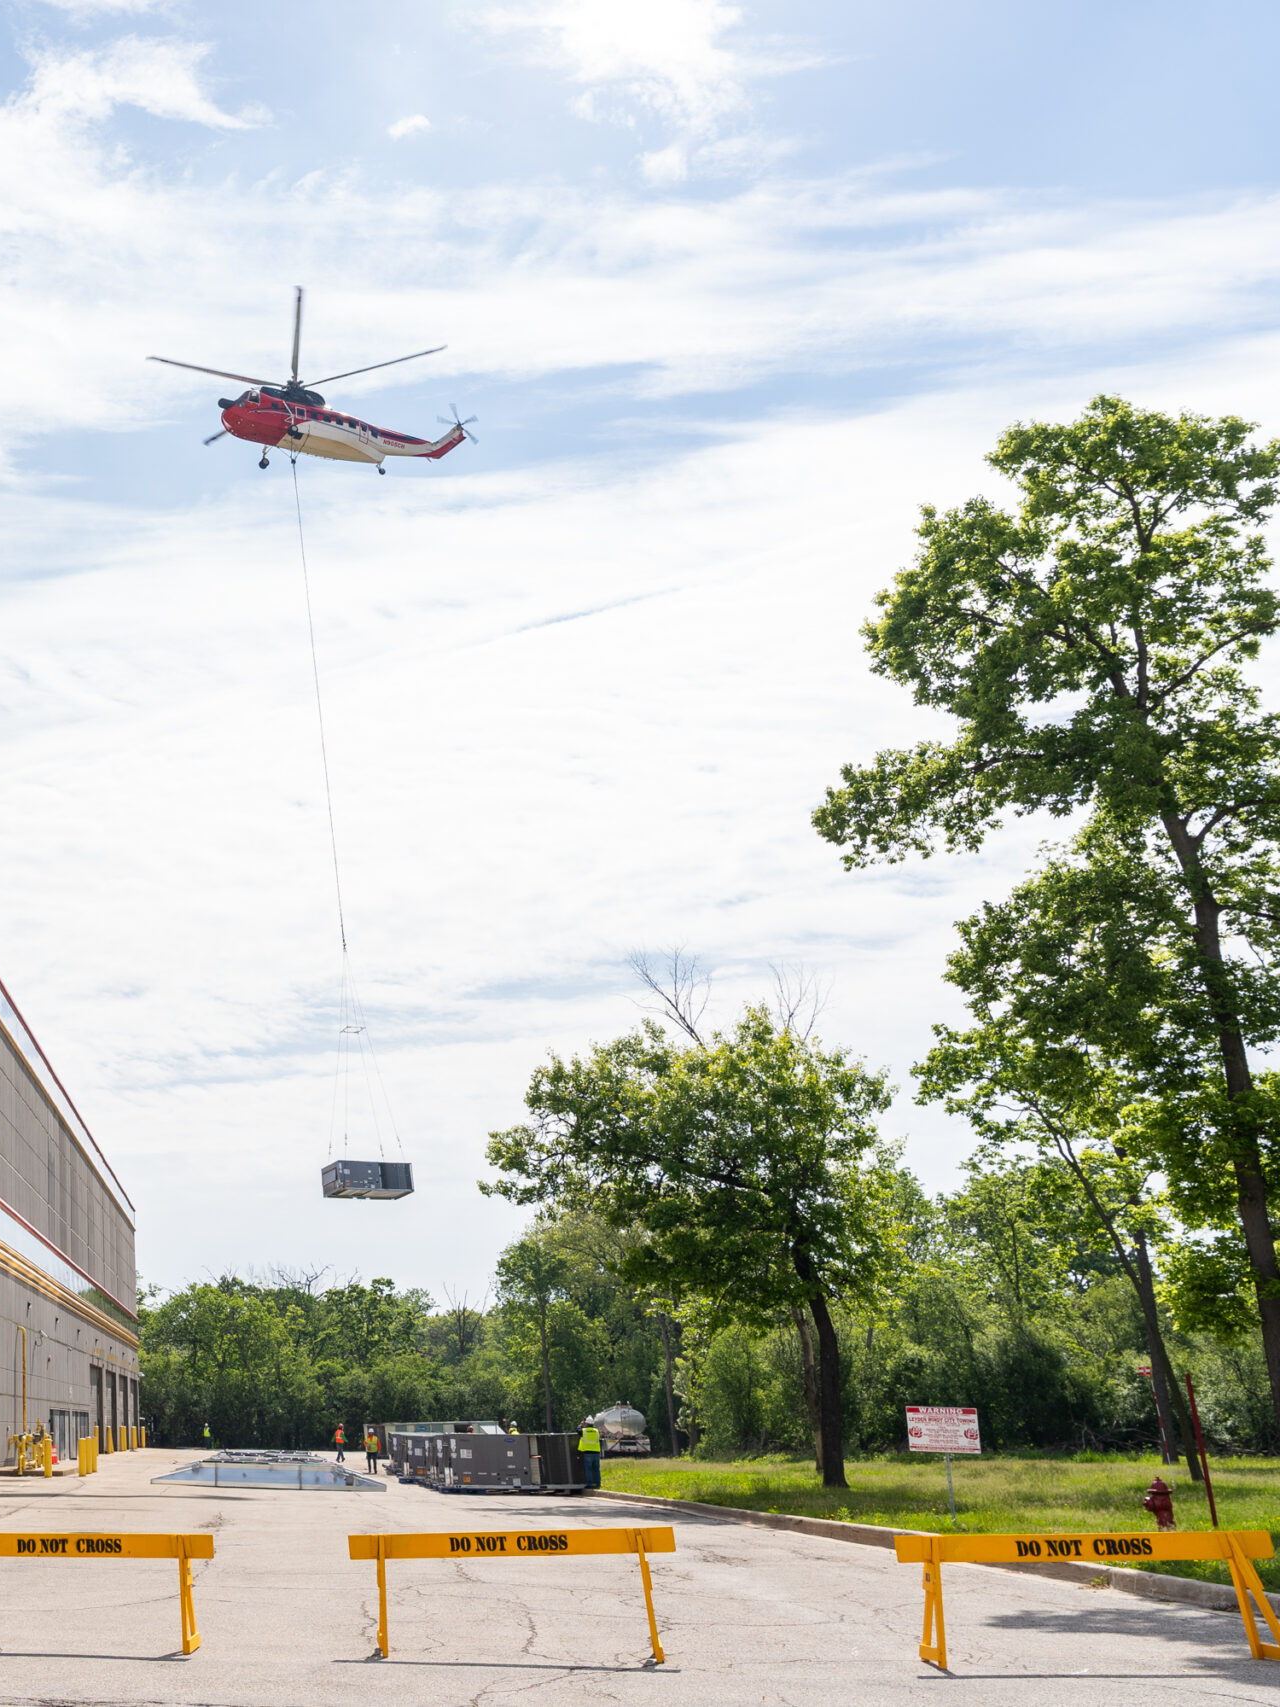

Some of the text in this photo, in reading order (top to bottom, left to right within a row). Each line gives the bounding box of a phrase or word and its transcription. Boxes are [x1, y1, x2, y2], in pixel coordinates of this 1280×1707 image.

[17, 1538, 122, 1553] DO NOT CROSS
[449, 1534, 568, 1552] DO NOT CROSS
[1015, 1538, 1153, 1557] DO NOT CROSS
